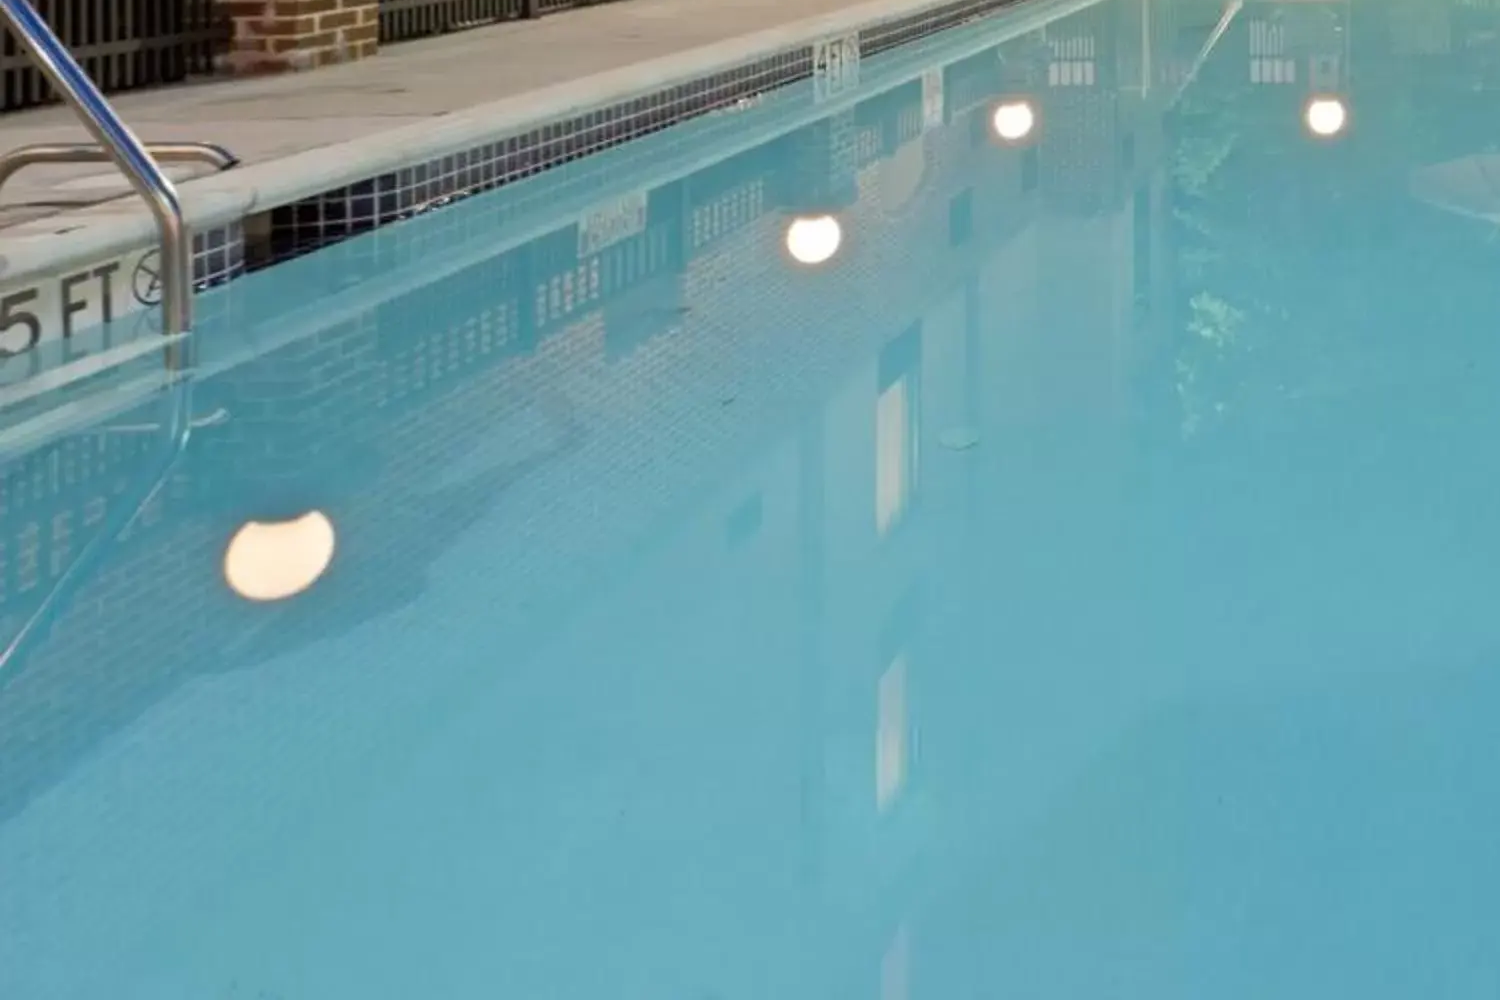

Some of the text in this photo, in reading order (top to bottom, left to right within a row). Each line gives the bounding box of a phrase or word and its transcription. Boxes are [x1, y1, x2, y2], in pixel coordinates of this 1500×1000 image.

[817, 44, 827, 72] 4
[0, 261, 120, 358] 5 FT
